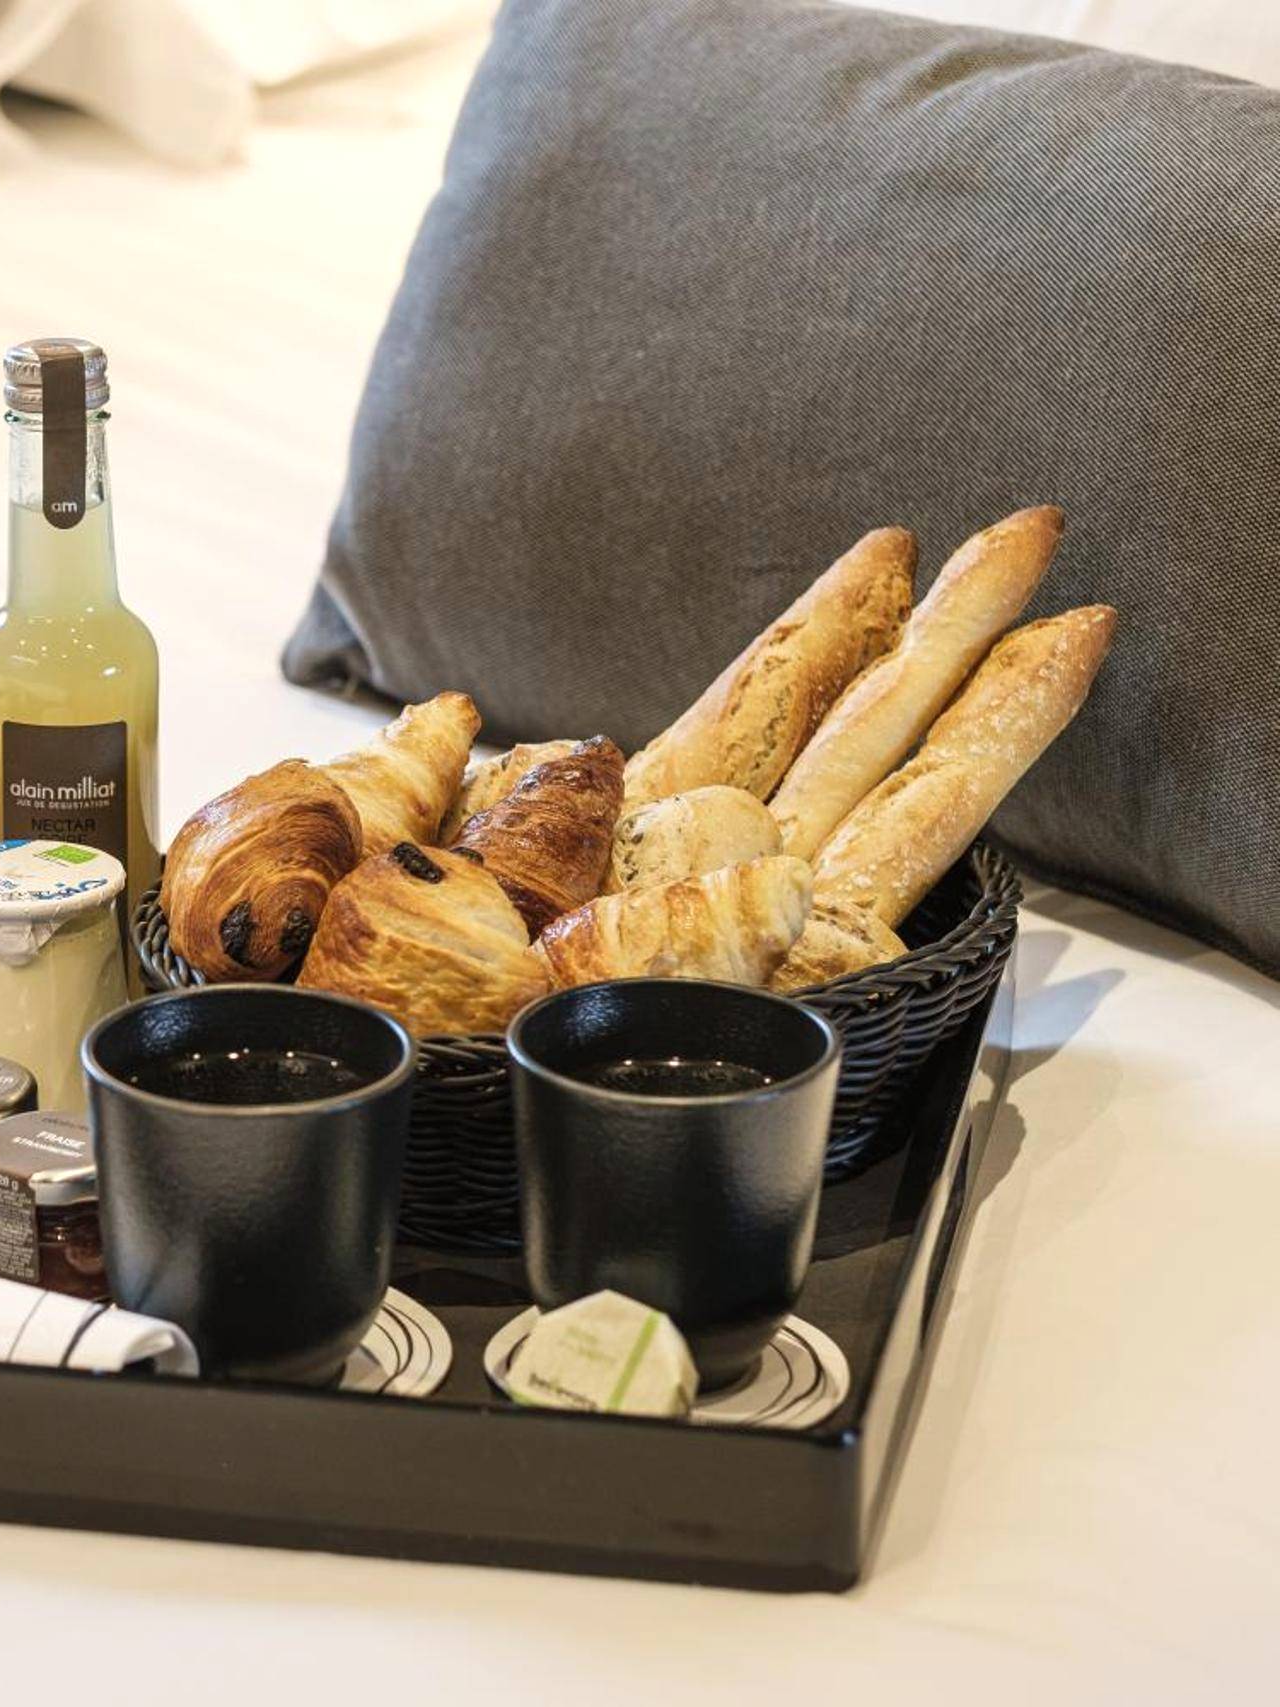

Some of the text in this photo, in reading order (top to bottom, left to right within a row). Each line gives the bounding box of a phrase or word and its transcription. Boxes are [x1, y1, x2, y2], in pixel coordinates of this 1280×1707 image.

[51, 500, 77, 514] am
[10, 775, 116, 800] alain milliat
[34, 801, 45, 809] DE
[31, 818, 96, 832] NECTAR
[36, 1131, 86, 1149] FRAISE
